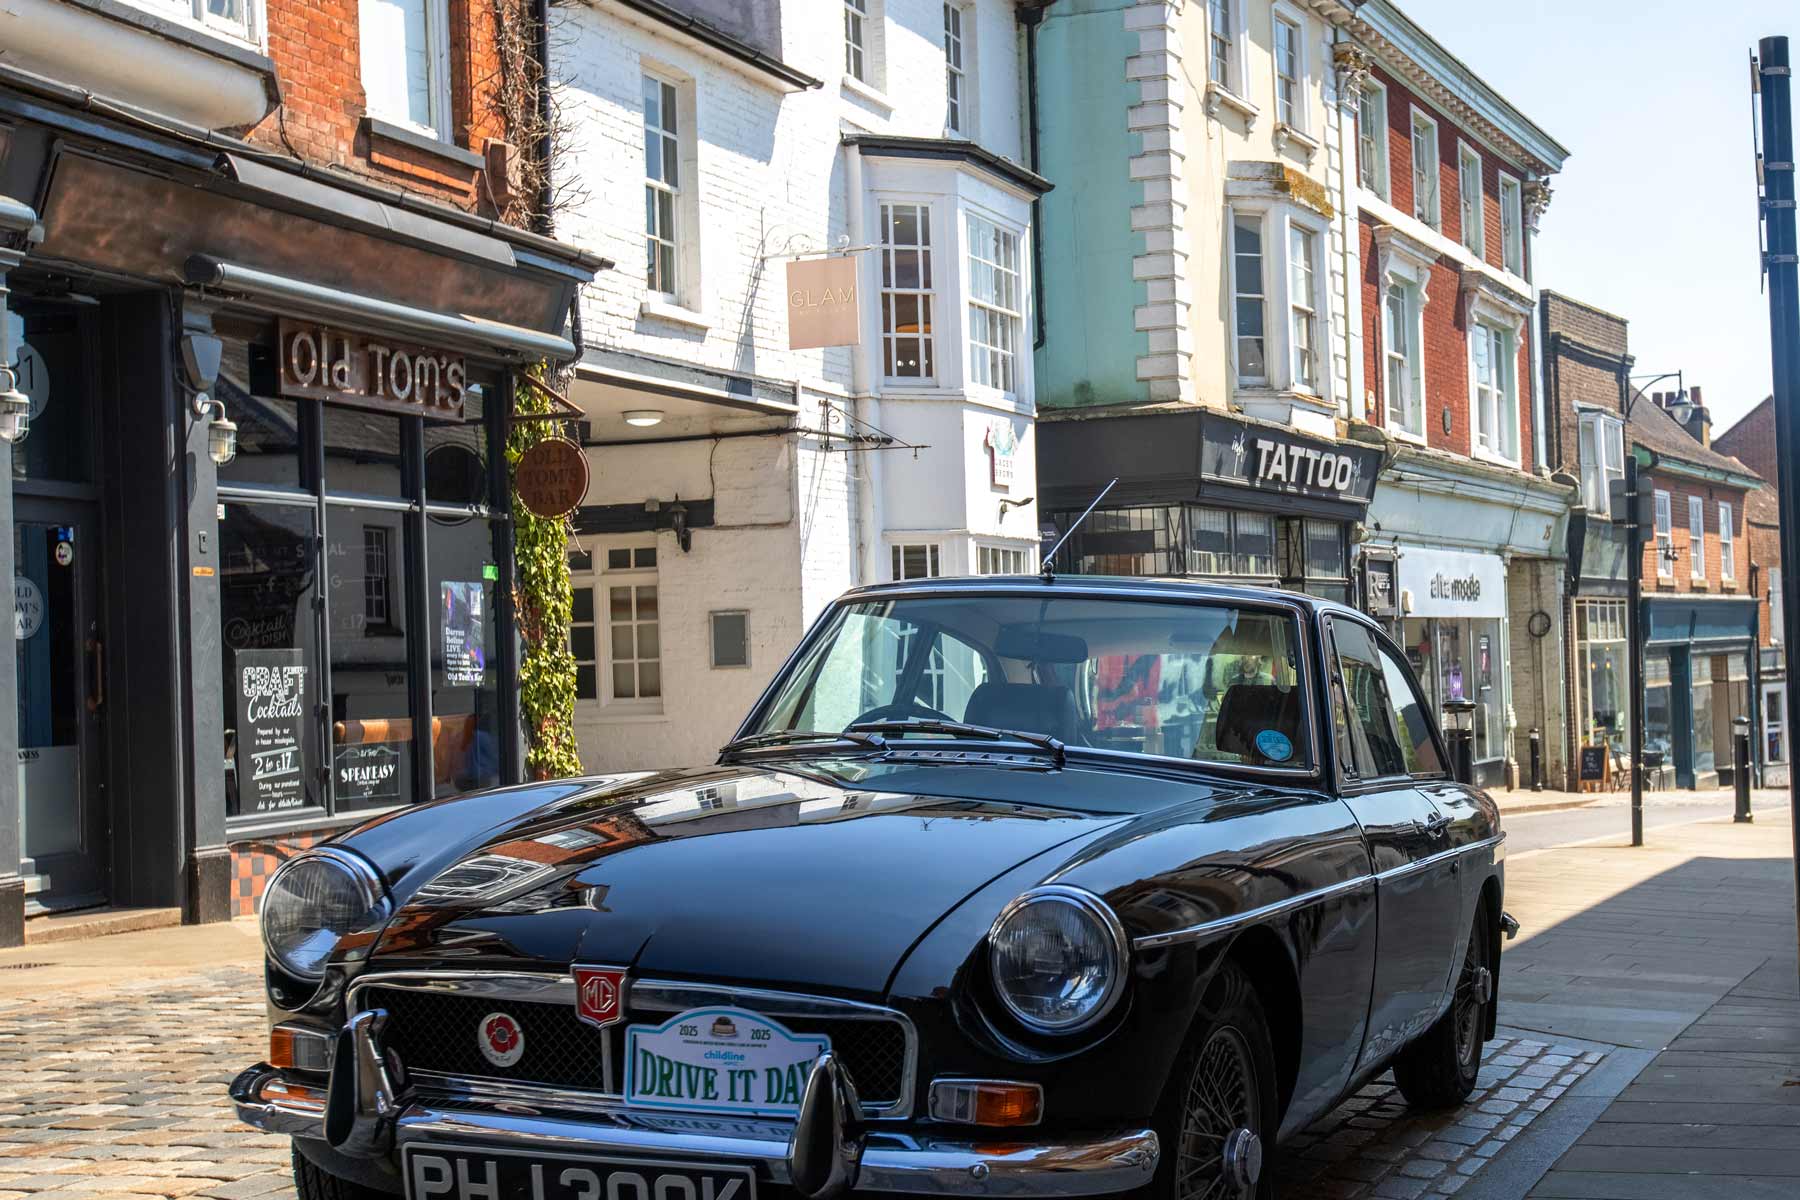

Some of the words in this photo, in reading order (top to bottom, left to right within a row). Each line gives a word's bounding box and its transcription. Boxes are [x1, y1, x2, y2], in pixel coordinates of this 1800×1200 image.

[790, 285, 855, 307] GLAM
[292, 331, 350, 391] Old
[1257, 439, 1352, 491] TATTOO
[15, 585, 32, 598] LD
[243, 666, 308, 698] CRAFT
[248, 693, 303, 723] Cocktails
[254, 757, 264, 776] 2
[276, 751, 292, 772] £17
[340, 764, 396, 784] SPEAKEASY
[586, 979, 614, 1010] MG
[679, 1024, 699, 1037] 2025
[751, 1028, 772, 1041] 2025
[703, 1049, 746, 1063] childline
[638, 1048, 719, 1101] DRIVE
[727, 1068, 759, 1102] IT
